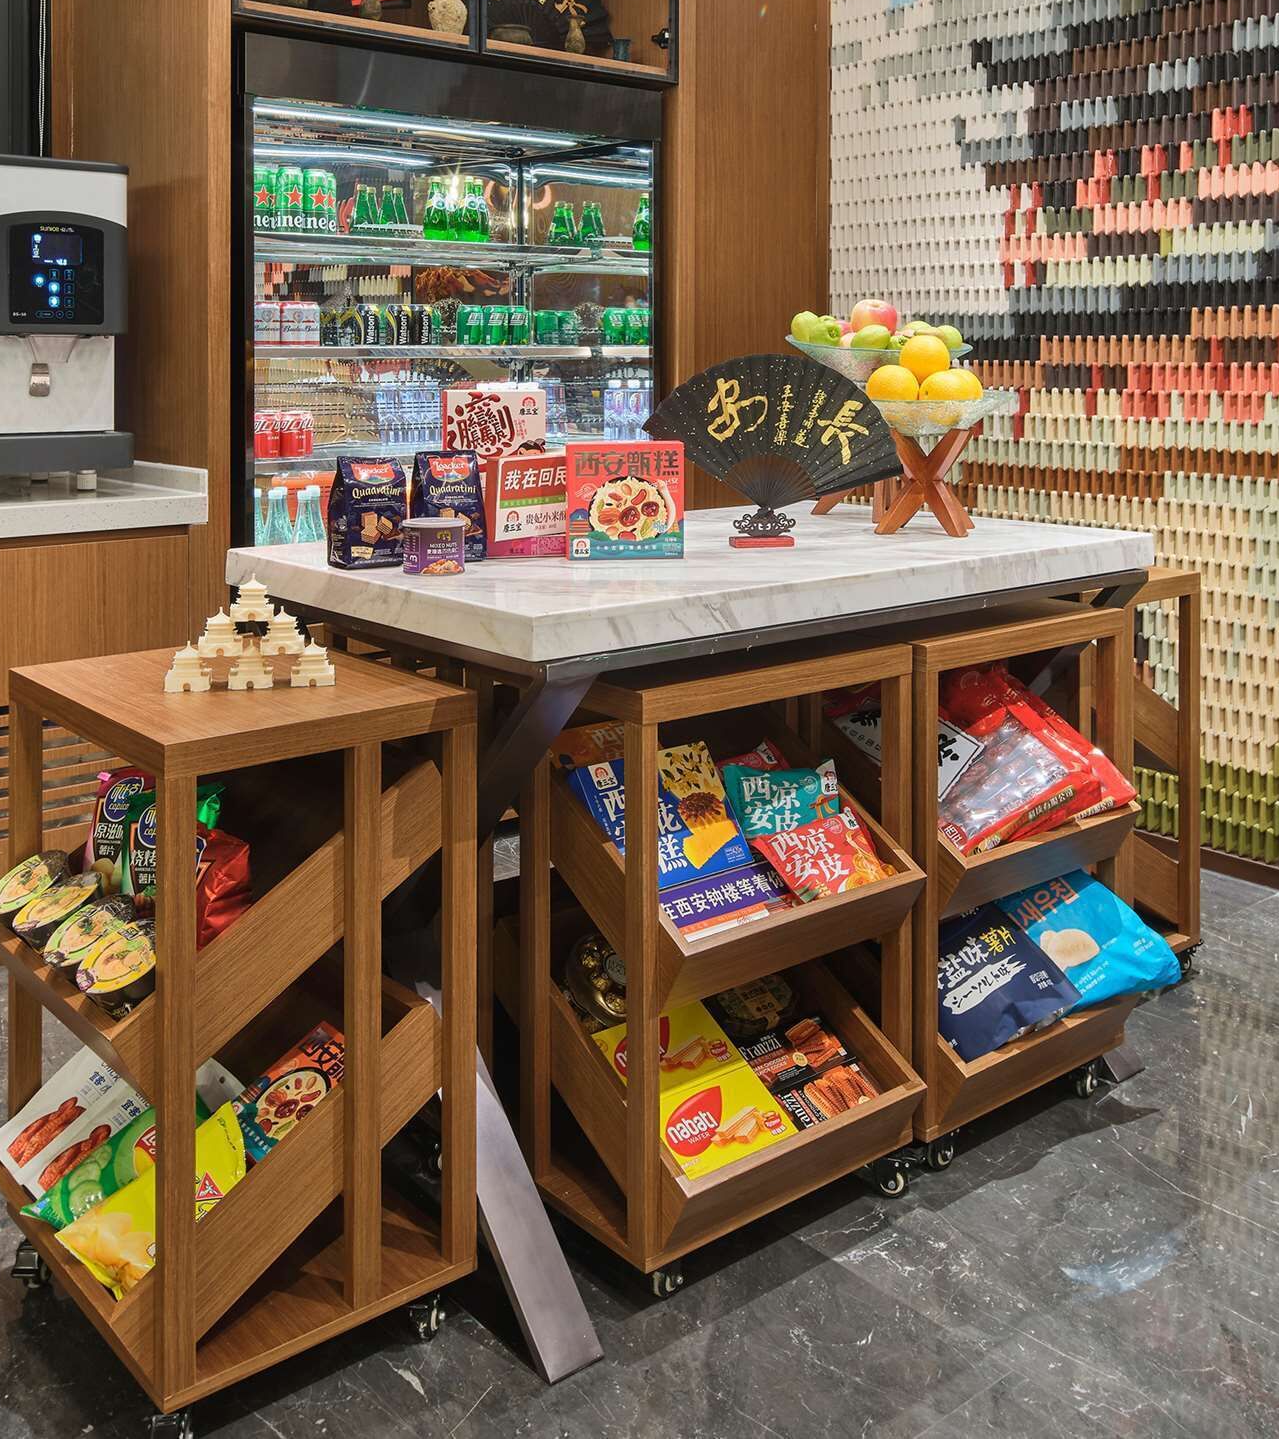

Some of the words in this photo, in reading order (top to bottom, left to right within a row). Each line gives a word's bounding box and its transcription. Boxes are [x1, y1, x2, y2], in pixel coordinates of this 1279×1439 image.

[366, 309, 376, 345] Watson's
[399, 310, 410, 345] Watson's
[420, 309, 430, 345] Watson's
[352, 485, 401, 500] Quadratini
[429, 484, 477, 497] Quadratini
[739, 1038, 782, 1061] Franzzi
[667, 1110, 719, 1144] nabati
[781, 1092, 815, 1130] ranzzi
[687, 1131, 711, 1145] WAFER
